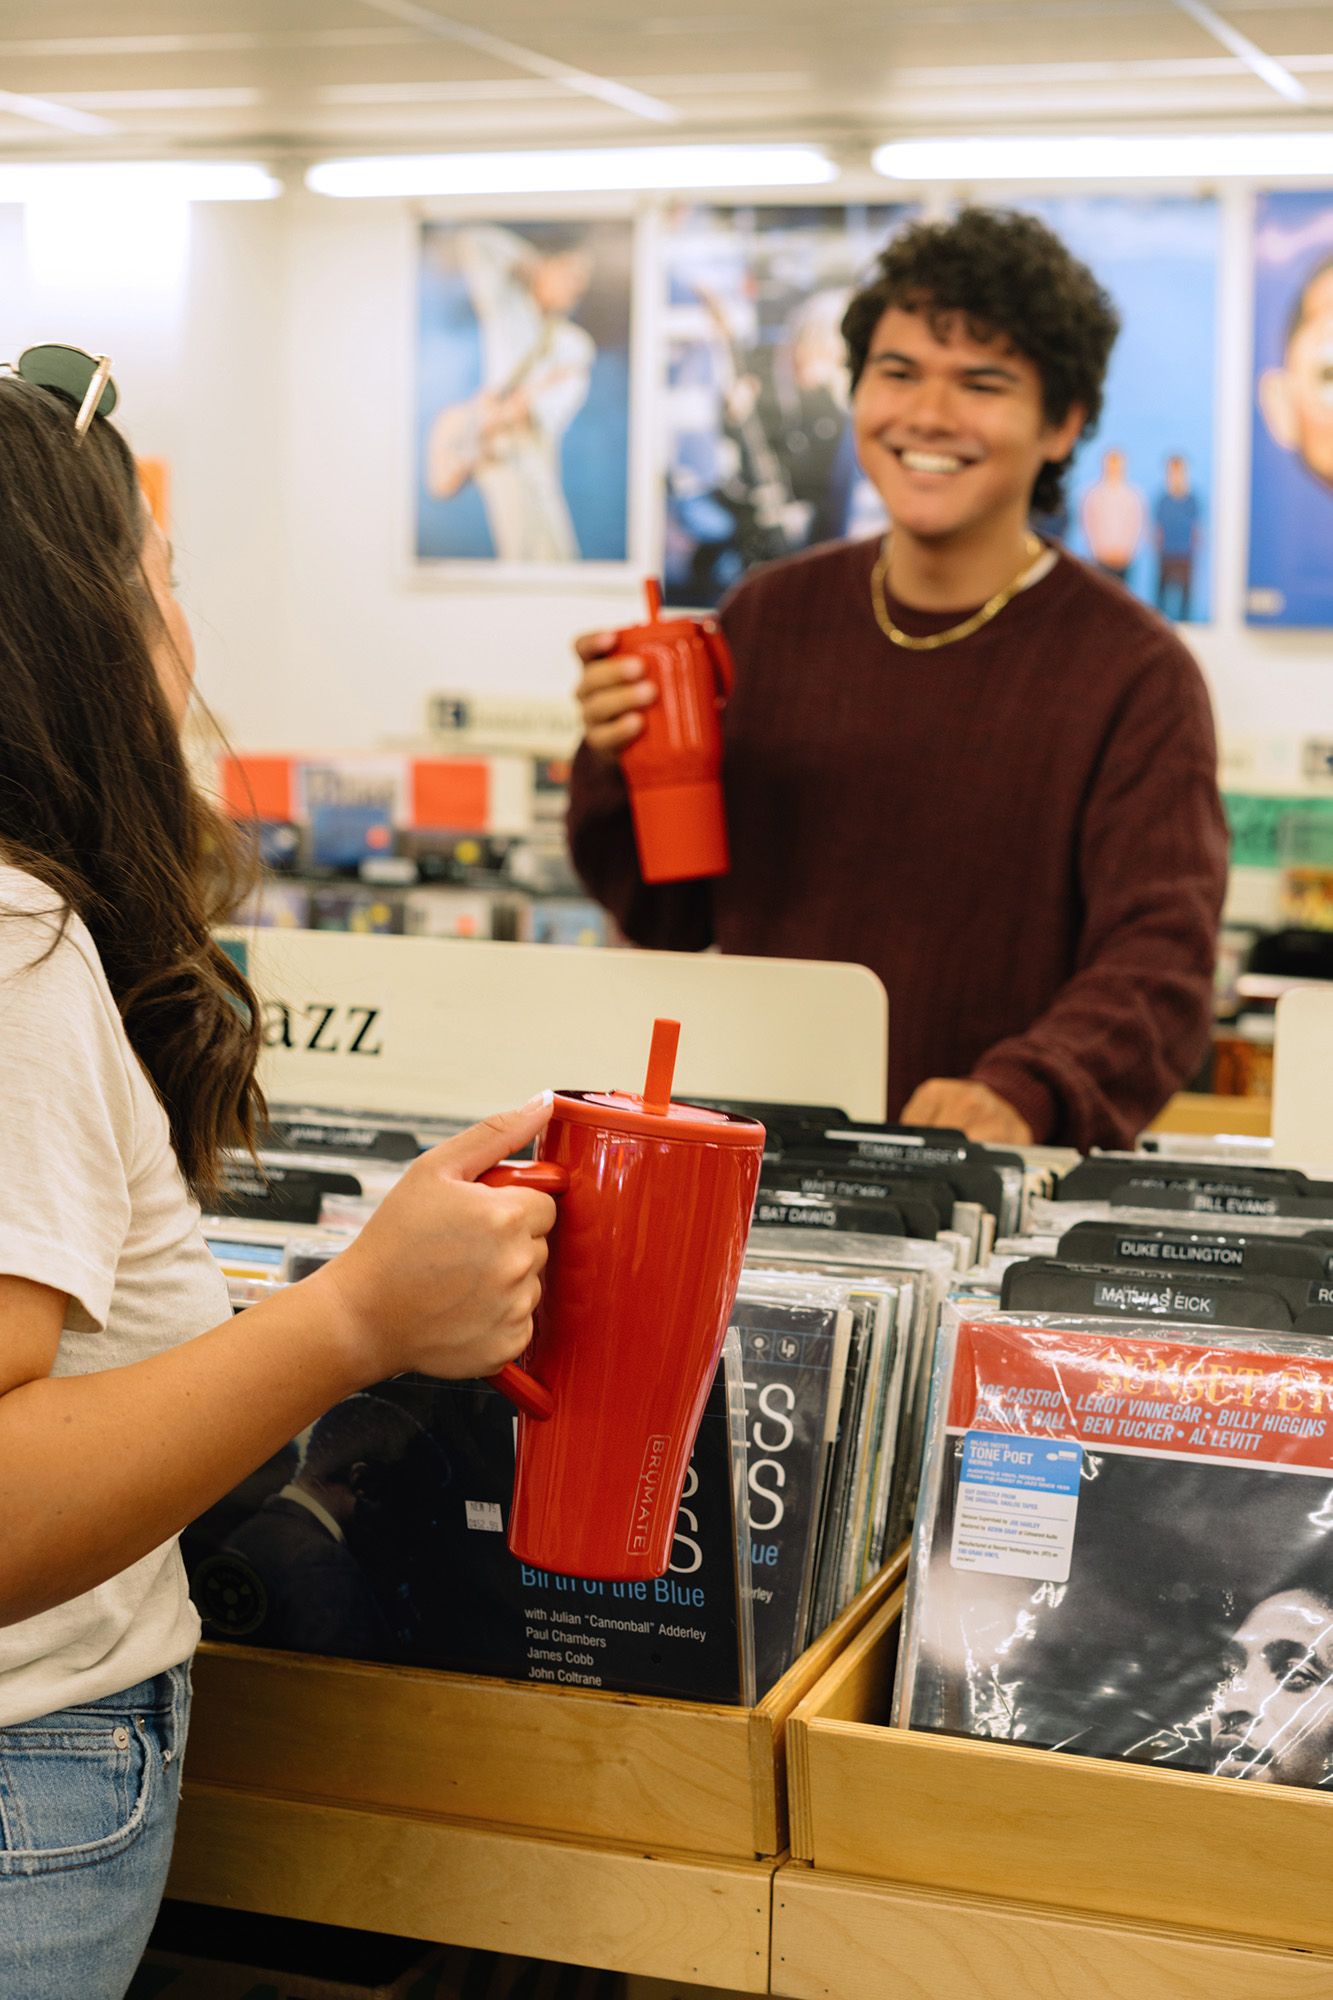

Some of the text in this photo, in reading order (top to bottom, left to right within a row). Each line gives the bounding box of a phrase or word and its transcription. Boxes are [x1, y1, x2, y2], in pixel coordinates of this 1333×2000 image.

[262, 1001, 382, 1055] azz
[1121, 1241, 1243, 1264] DUKE ELLINGTON
[1101, 1287, 1211, 1312] MATHIAS EICK
[1005, 1386, 1063, 1408] CASTRO
[1076, 1394, 1125, 1414] LEROY
[1128, 1400, 1202, 1424] VINNEGAR
[1217, 1409, 1261, 1430] BILLY
[1262, 1415, 1328, 1437] HIGGINS
[1082, 1416, 1114, 1434] BEN
[1116, 1419, 1175, 1442] TUCKER
[1189, 1430, 1206, 1446] AL
[1211, 1431, 1263, 1451] LEVITT
[970, 1447, 1034, 1465] TONE POET
[654, 1578, 705, 1607] Blue
[524, 1607, 547, 1621] with
[550, 1610, 581, 1625] Julian
[658, 1624, 706, 1643] Adderley
[525, 1627, 607, 1648] Paul Chambers
[527, 1646, 594, 1666] James Cobb
[528, 1666, 602, 1687] John Coltrane
